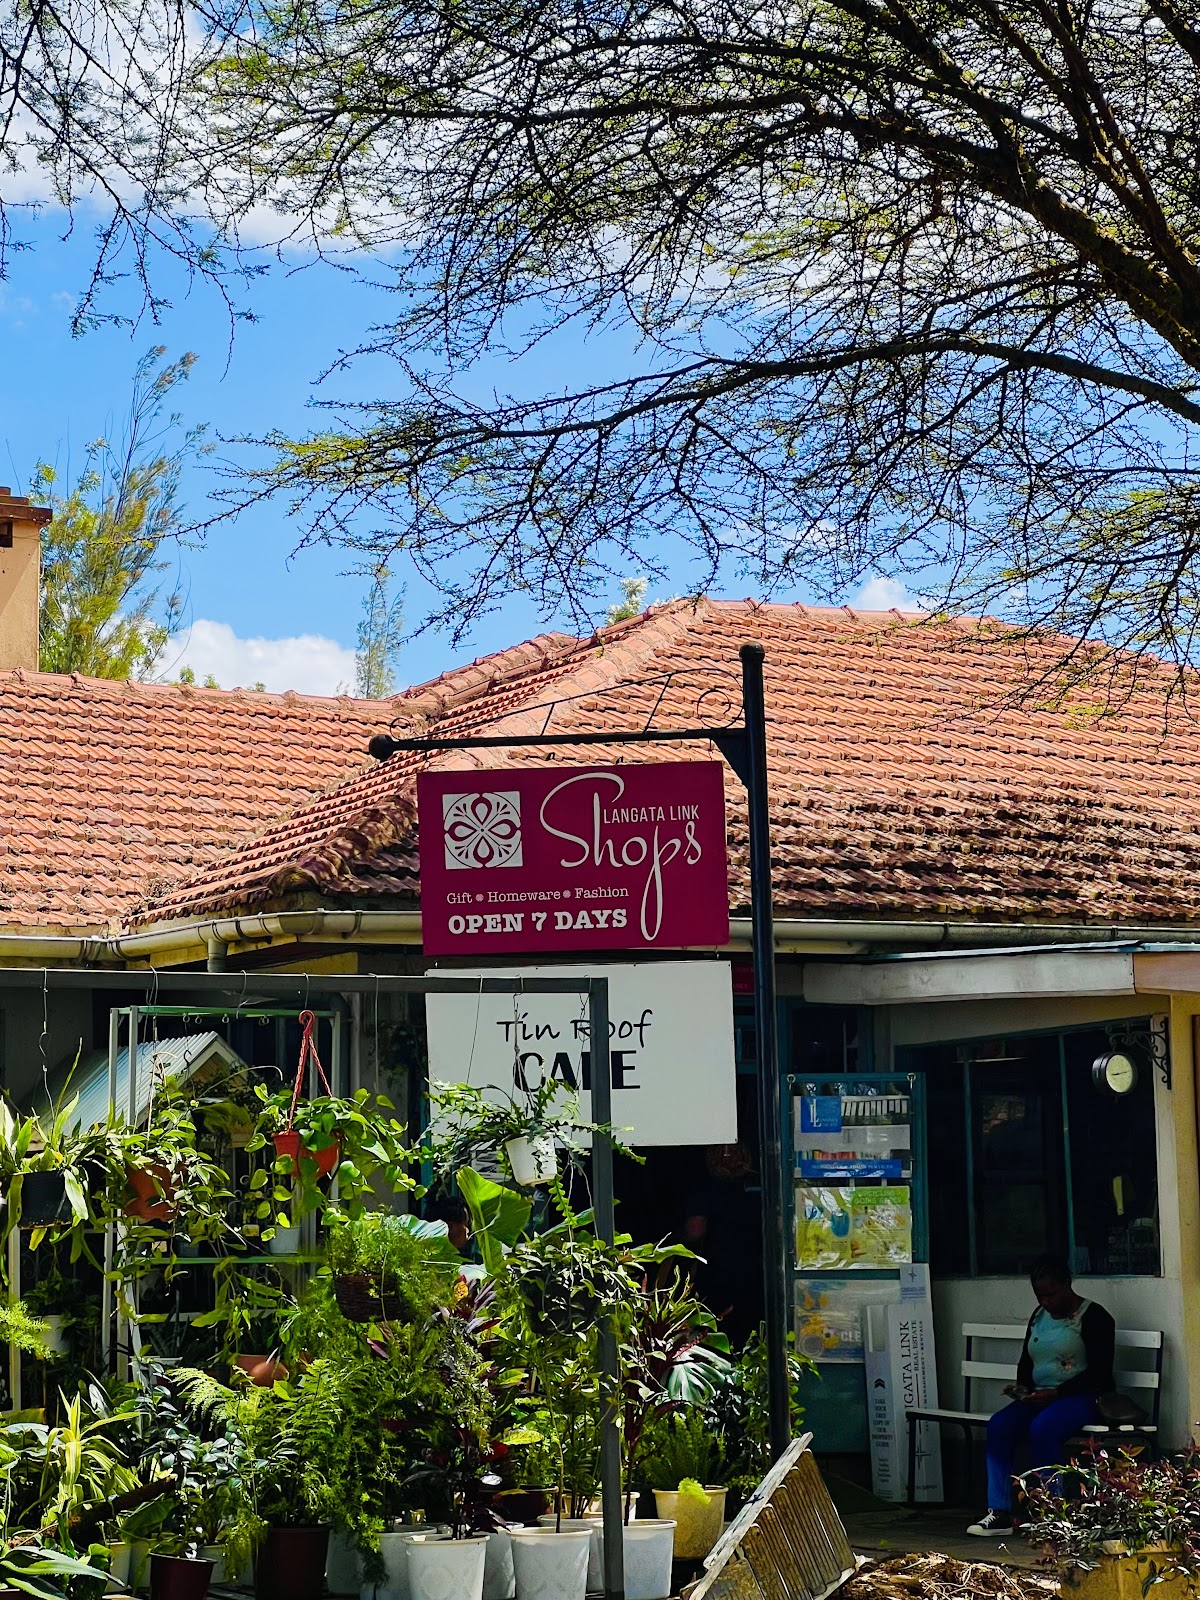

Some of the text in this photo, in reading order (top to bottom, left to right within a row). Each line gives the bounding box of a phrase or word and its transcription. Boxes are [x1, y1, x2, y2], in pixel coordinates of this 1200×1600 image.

[603, 804, 700, 825] LANGATA LINK
[540, 772, 702, 941] Shops
[446, 886, 629, 905] Gift Homeware Fashion
[448, 909, 628, 935] OPEN 7 DAYS
[496, 1012, 560, 1042] Tin
[899, 1321, 911, 1358] LINK
[911, 1319, 919, 1349] ESTATE
